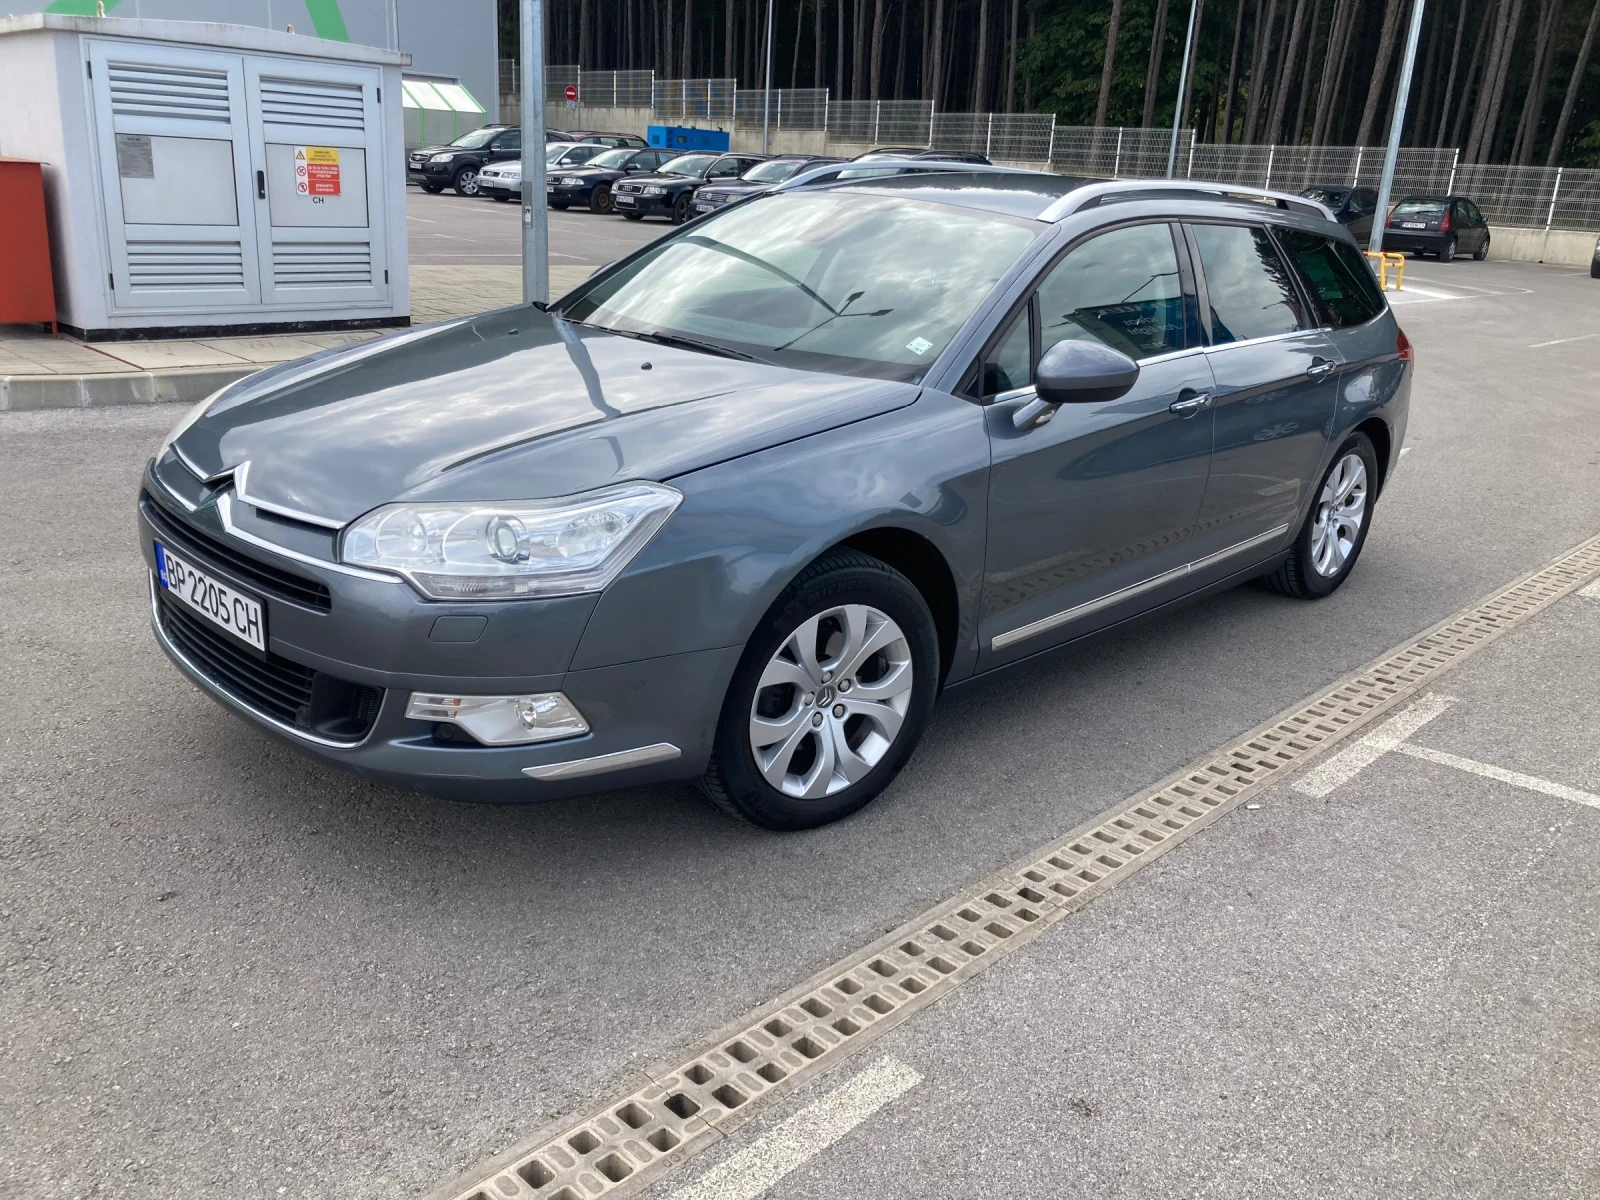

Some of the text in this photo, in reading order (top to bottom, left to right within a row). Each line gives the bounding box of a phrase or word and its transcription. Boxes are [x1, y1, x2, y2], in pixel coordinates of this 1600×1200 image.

[165, 554, 261, 644] BP 2205 CH
